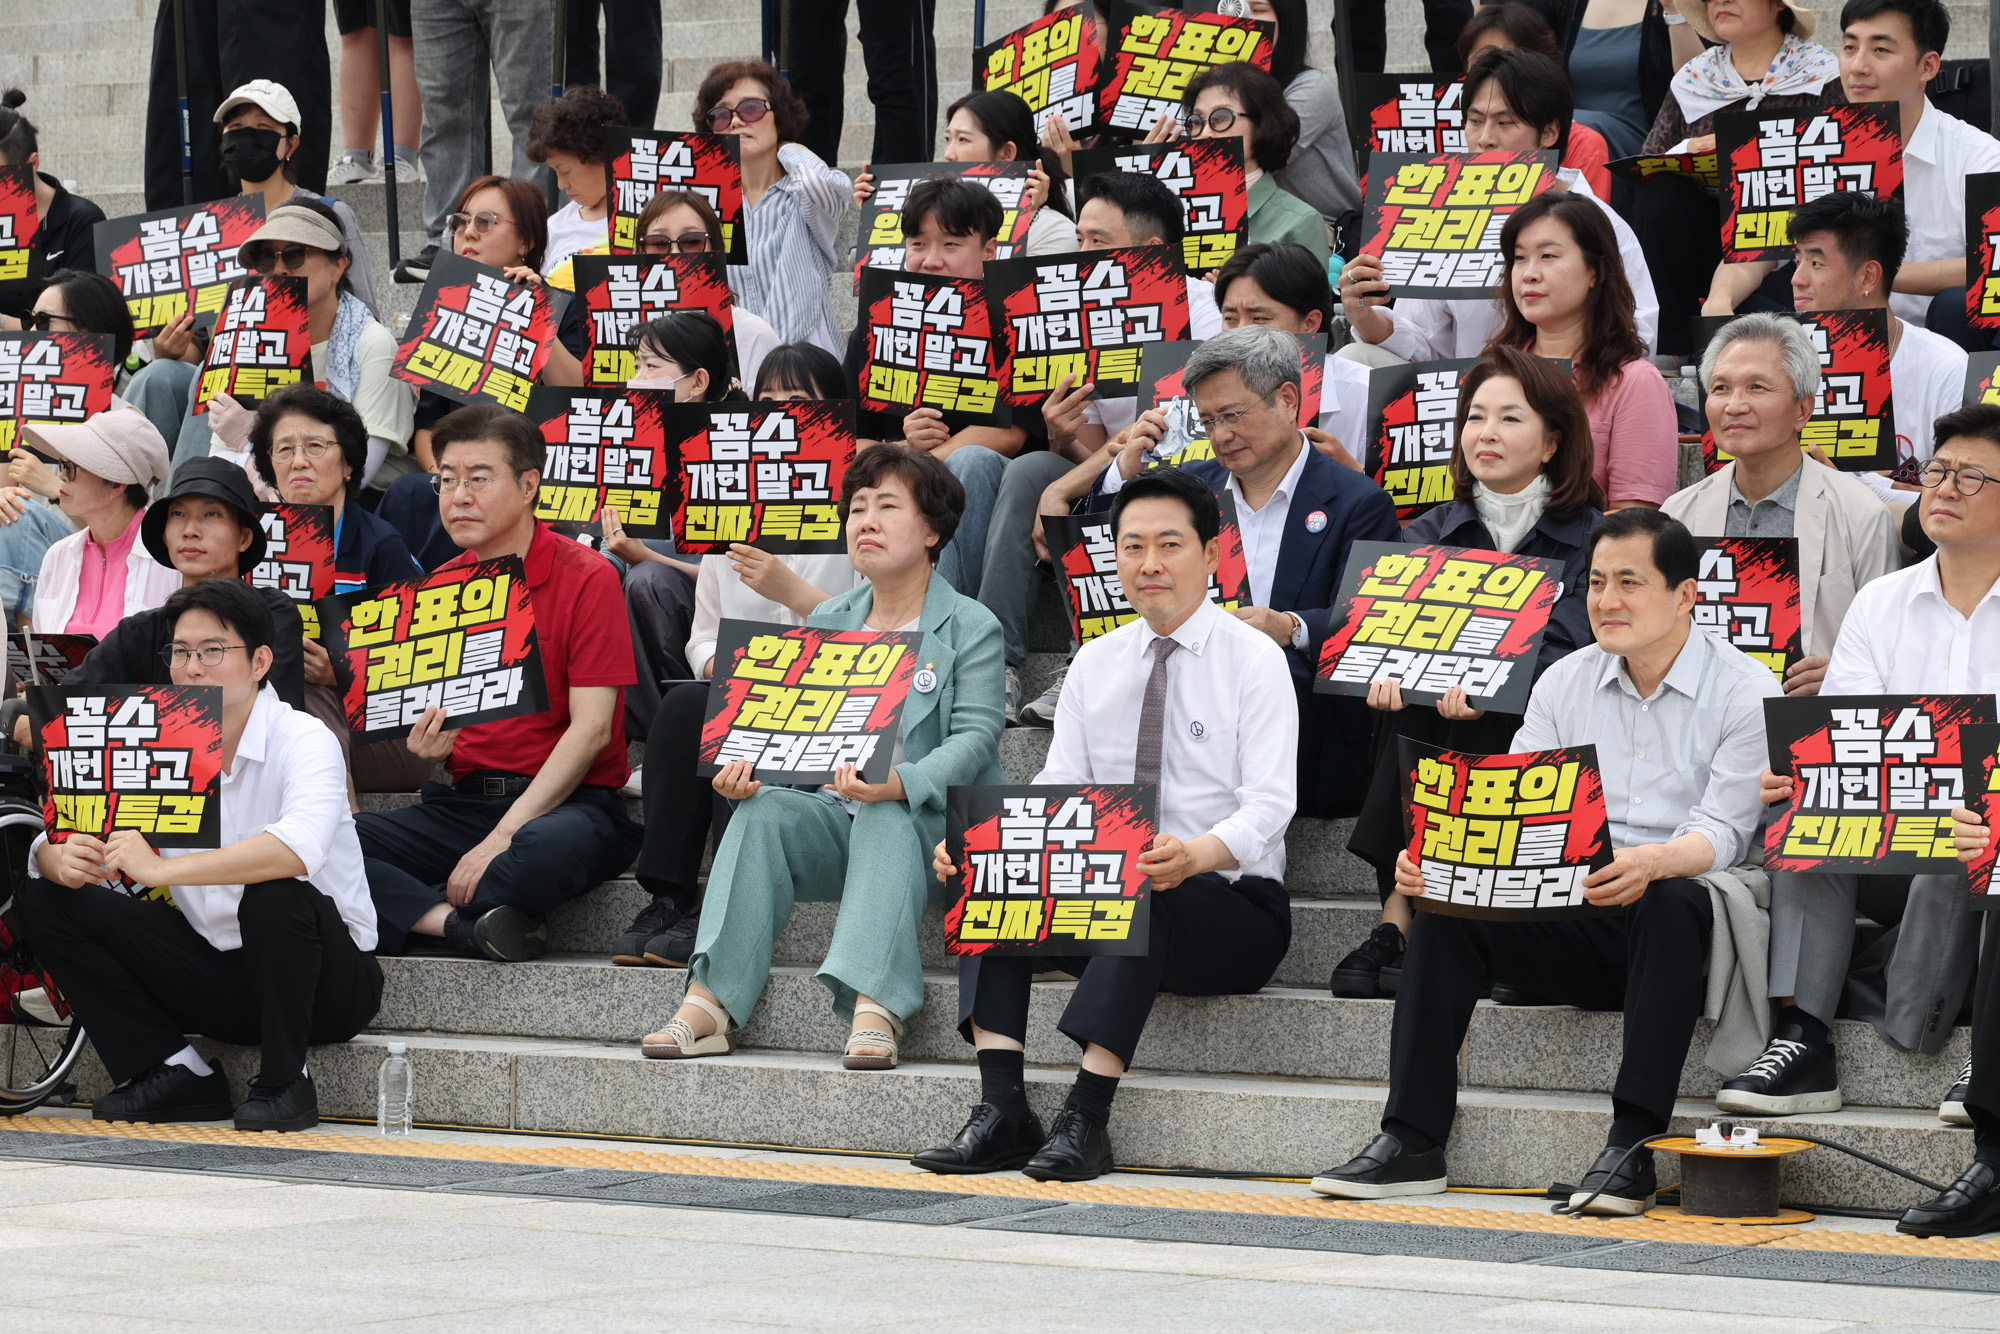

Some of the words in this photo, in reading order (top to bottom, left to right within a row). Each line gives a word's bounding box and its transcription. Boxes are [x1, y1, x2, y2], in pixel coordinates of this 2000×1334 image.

[986, 43, 1016, 92] 한
[1019, 14, 1083, 77] 표의
[1120, 14, 1170, 55] 한
[1168, 21, 1262, 65] 표의
[630, 138, 694, 183] 꼼수
[1758, 115, 1842, 168] 꼼수
[1384, 163, 1446, 205] 한
[1445, 162, 1545, 206] 표의
[1737, 168, 1796, 207] 개헌
[1803, 164, 1877, 203] 말고
[139, 211, 220, 261] 꼼수
[118, 258, 182, 296] 개헌
[187, 246, 247, 287] 말고
[607, 264, 678, 308] 꼼수
[1035, 259, 1129, 312] 꼼수
[1379, 251, 1505, 287] 돌려달
[195, 282, 232, 314] 특
[224, 286, 266, 331] 꼼수
[465, 273, 535, 332] 꼼수
[892, 281, 964, 332] 꼼수
[208, 331, 236, 366] 개헌
[234, 330, 288, 364] 말고
[429, 307, 493, 358] 개헌
[490, 330, 537, 375] 말고
[872, 326, 919, 367] 개헌
[923, 334, 988, 375] 말고
[1012, 311, 1081, 352] 개헌
[1089, 305, 1163, 347] 말고
[405, 341, 484, 392] 진짜
[481, 367, 534, 413] 특검
[868, 365, 919, 405] 진짜
[922, 373, 998, 414] 특검
[1012, 352, 1088, 393] 진짜
[1097, 347, 1143, 383] 특
[22, 383, 86, 418] 말고
[1415, 370, 1460, 421] 꼼
[568, 397, 635, 445] 꼼수
[709, 412, 798, 461] 꼼수
[1389, 421, 1454, 463] 개헌
[1800, 418, 1881, 458] 특검
[542, 445, 597, 482] 개헌
[603, 448, 652, 485] 말고
[686, 462, 748, 500] 개헌
[757, 462, 833, 500] 말고
[1383, 465, 1455, 506] 진짜
[536, 485, 599, 522] 진짜
[603, 488, 662, 525] 특검
[685, 505, 752, 541] 진짜
[760, 504, 841, 541] 특검
[1357, 554, 1429, 597] 한
[1419, 559, 1546, 611] 표의
[348, 596, 400, 648] 한
[408, 573, 511, 637] 표의
[1351, 600, 1513, 656] 권리를
[366, 629, 504, 692] 권리를
[733, 634, 802, 682] 한
[799, 642, 908, 686] 표의
[1329, 645, 1515, 697] 돌려달라
[65, 696, 158, 747] 꼼수
[365, 666, 523, 732] 돌려달라
[733, 683, 879, 733] 권리를
[713, 729, 881, 771] 돌려달라
[1830, 707, 1935, 763] 꼼수
[47, 750, 103, 790] 개헌
[112, 750, 190, 790] 말고
[1413, 757, 1455, 810] 한
[1461, 761, 1580, 815] 표의
[1801, 767, 1879, 810] 개헌
[1890, 767, 1966, 810] 말고
[51, 794, 108, 833] 진짜
[114, 795, 206, 833] 특검
[1000, 796, 1095, 850] 꼼수
[1782, 816, 1883, 857] 진짜
[1421, 811, 1568, 866] 권리를
[970, 853, 1040, 894] 개헌
[1050, 853, 1123, 894] 말고
[1419, 859, 1591, 908] 돌려달라
[959, 900, 1043, 940] 진짜
[1051, 900, 1136, 940] 특검
